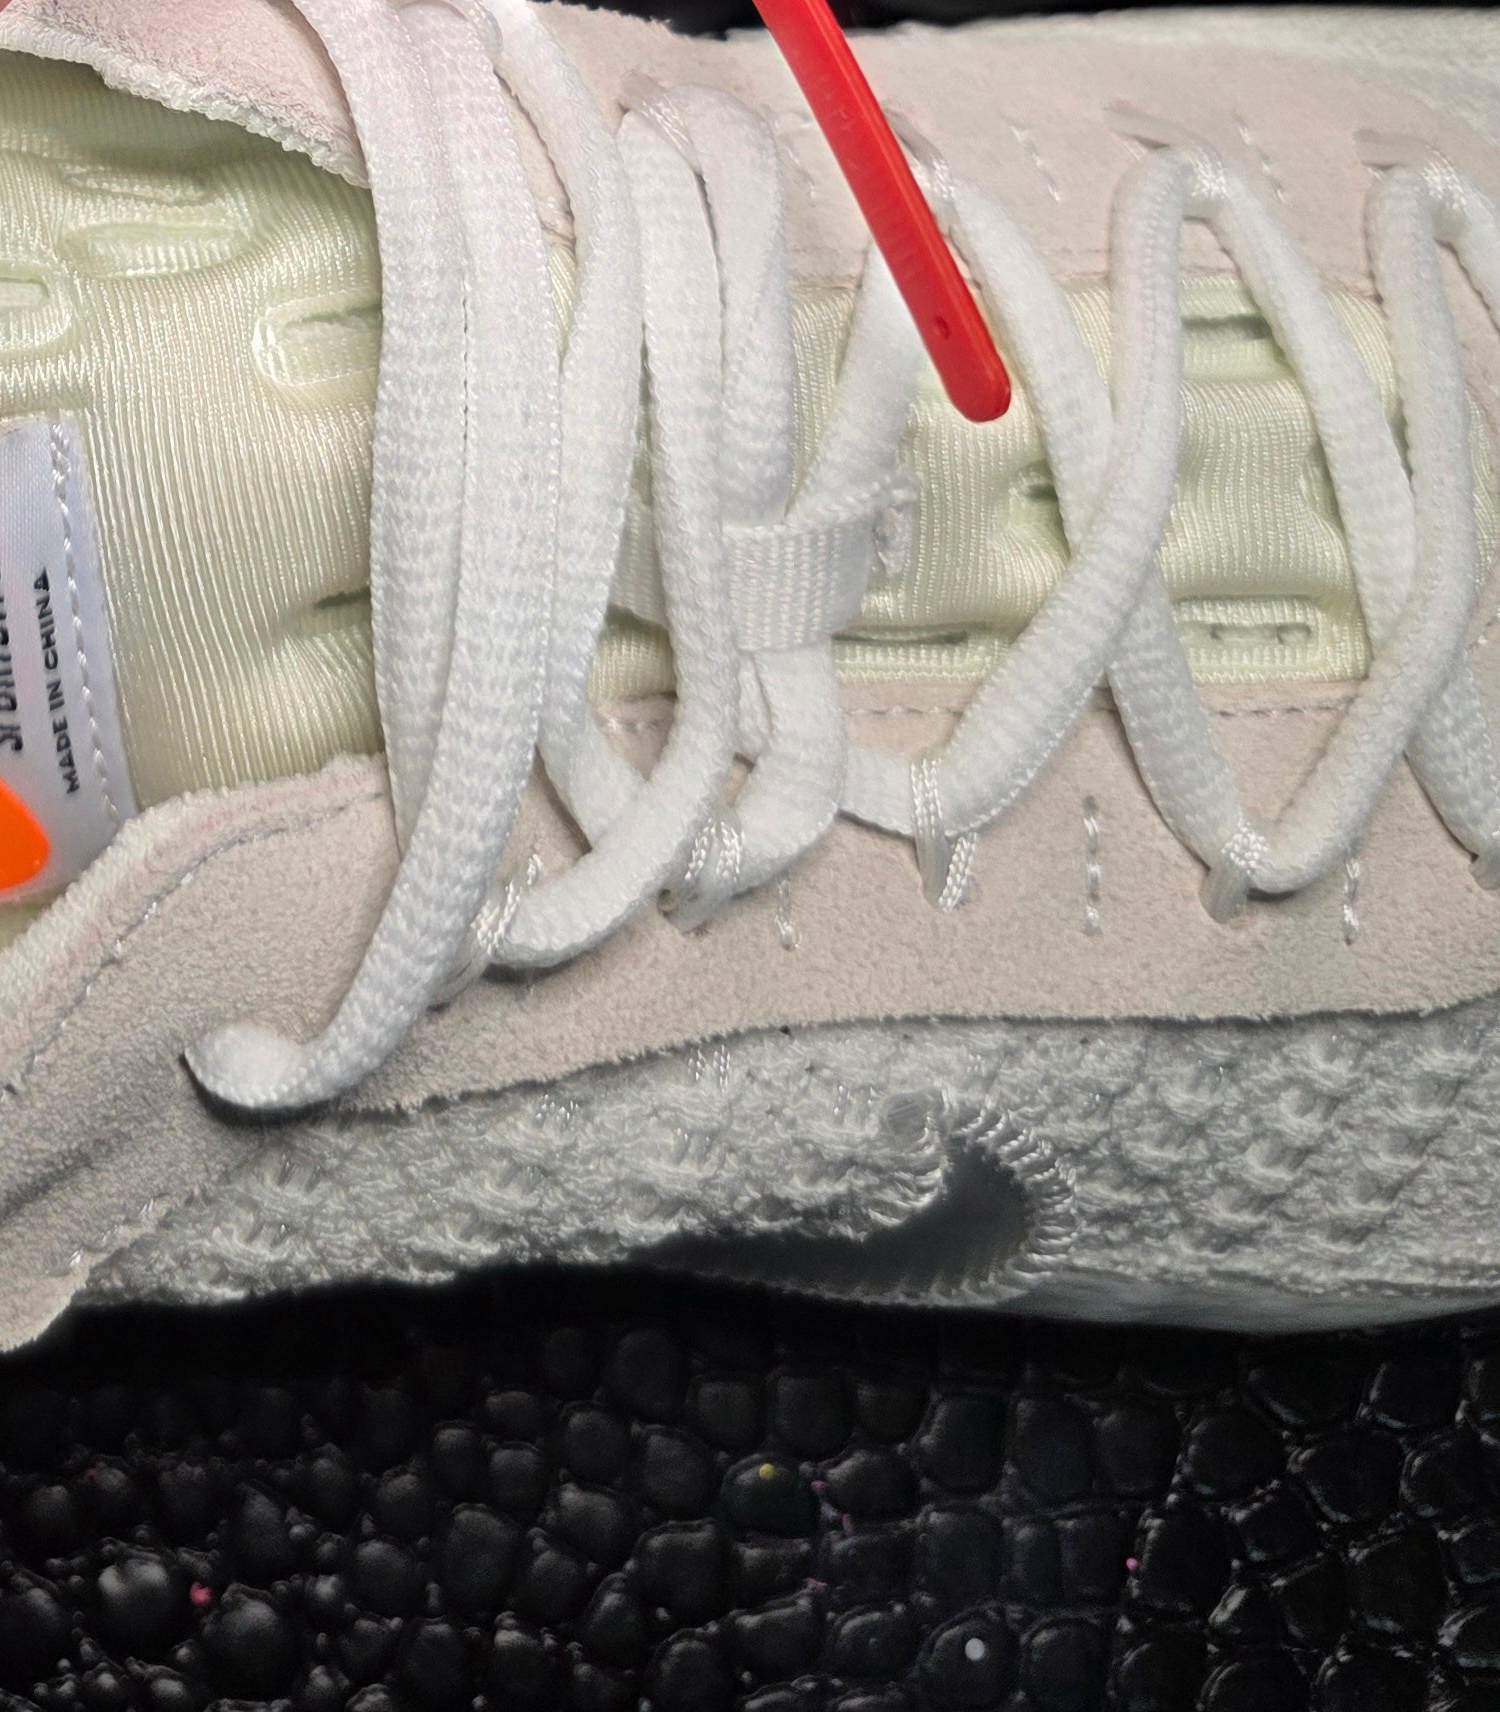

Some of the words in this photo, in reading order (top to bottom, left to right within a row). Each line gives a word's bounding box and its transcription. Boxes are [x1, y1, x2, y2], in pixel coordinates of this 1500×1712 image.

[34, 568, 59, 671] CHINA
[47, 678, 65, 711] IN
[52, 717, 80, 794] MADE
